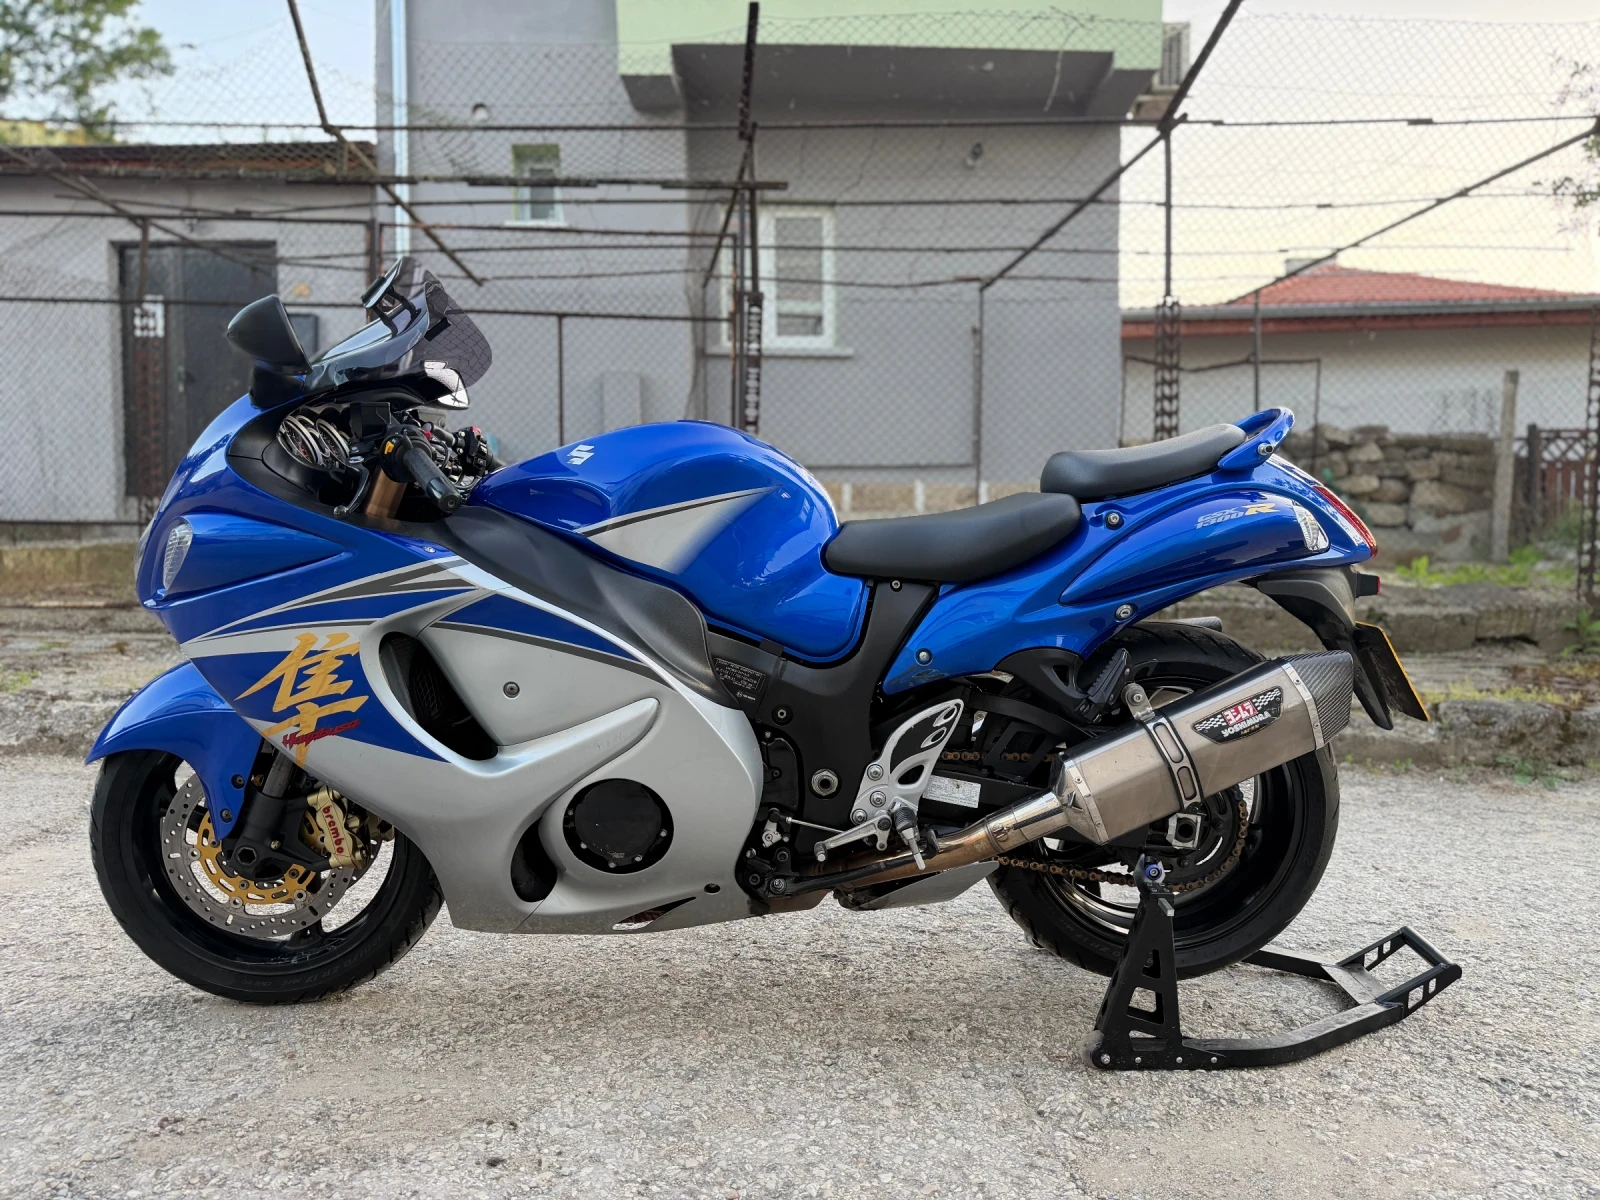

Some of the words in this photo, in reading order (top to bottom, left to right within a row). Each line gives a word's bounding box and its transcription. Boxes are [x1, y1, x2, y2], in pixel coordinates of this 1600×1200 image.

[281, 718, 362, 750] Hayabusa
[1220, 711, 1272, 738] YOSHIMURA
[322, 805, 344, 854] brembo
